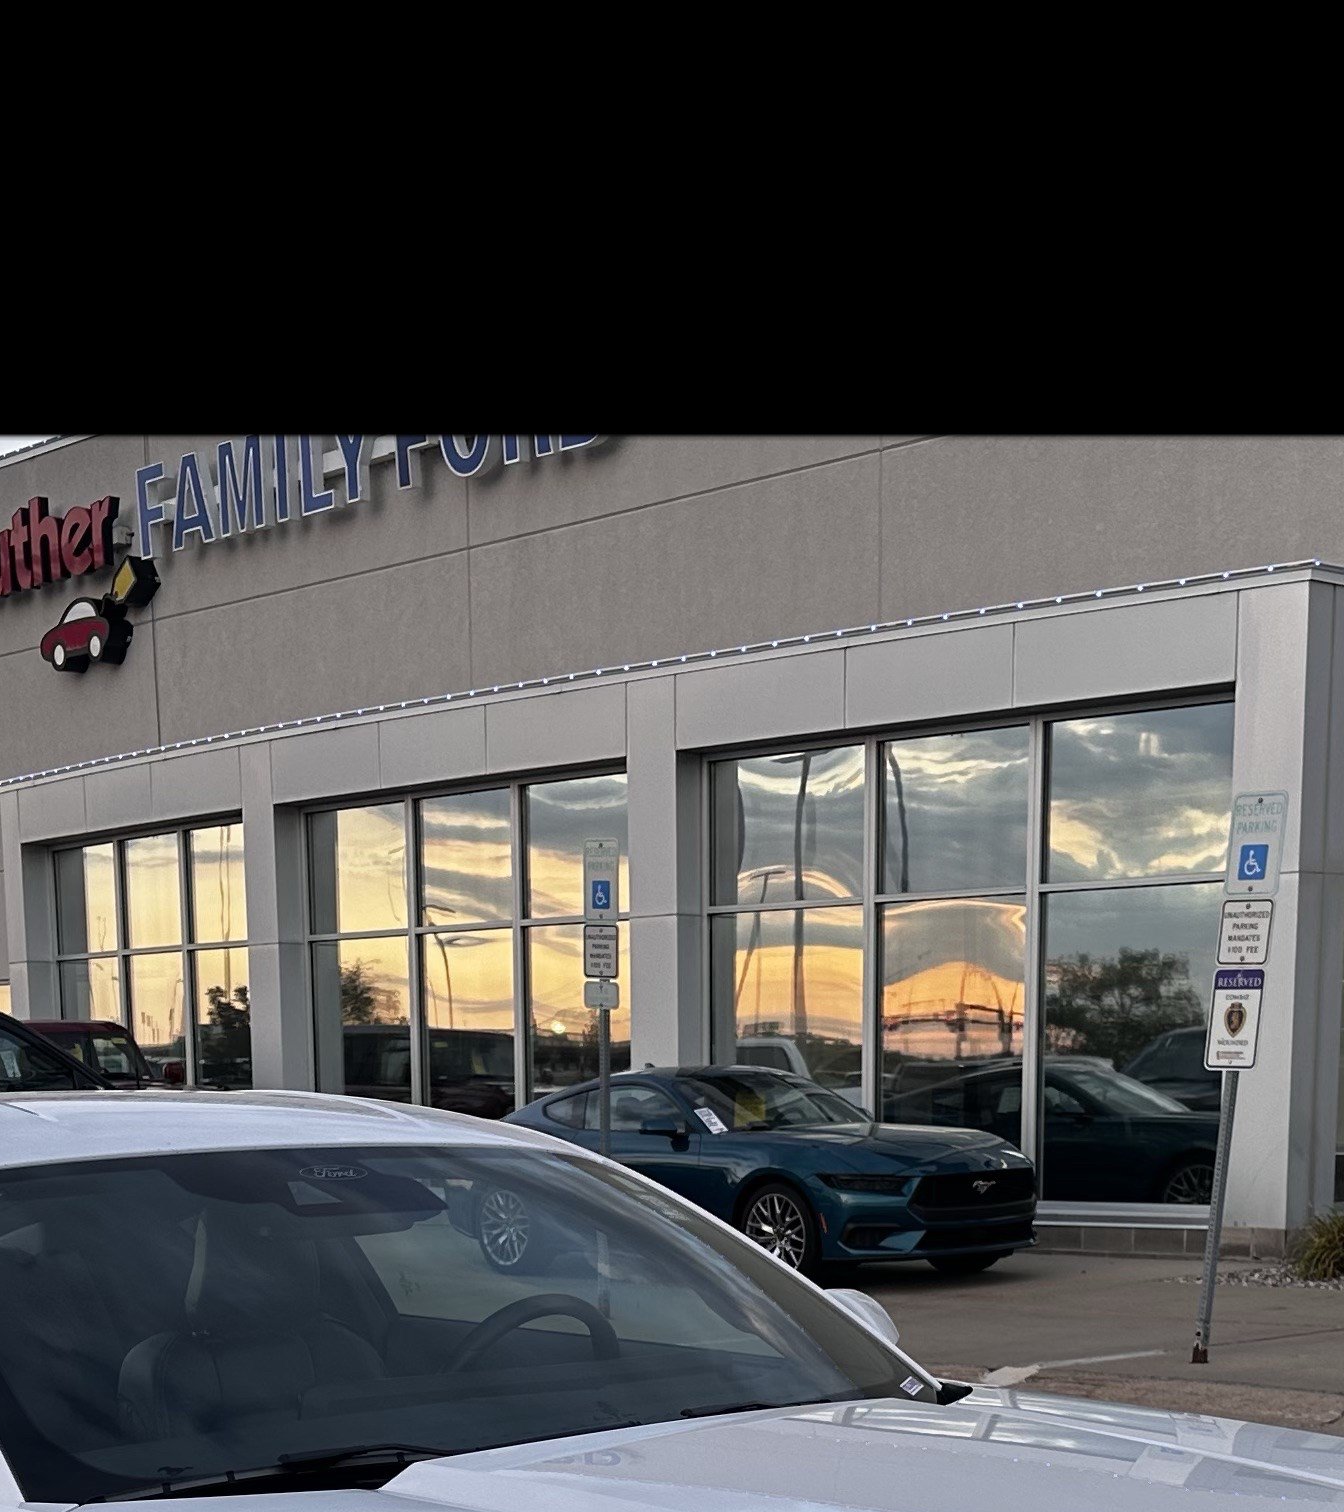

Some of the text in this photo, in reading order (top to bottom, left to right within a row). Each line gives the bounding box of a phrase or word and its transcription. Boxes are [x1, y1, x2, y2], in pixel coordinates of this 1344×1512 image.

[135, 434, 366, 561] FAMILY
[1217, 977, 1262, 988] RESERVED
[313, 1166, 357, 1178] Ford
